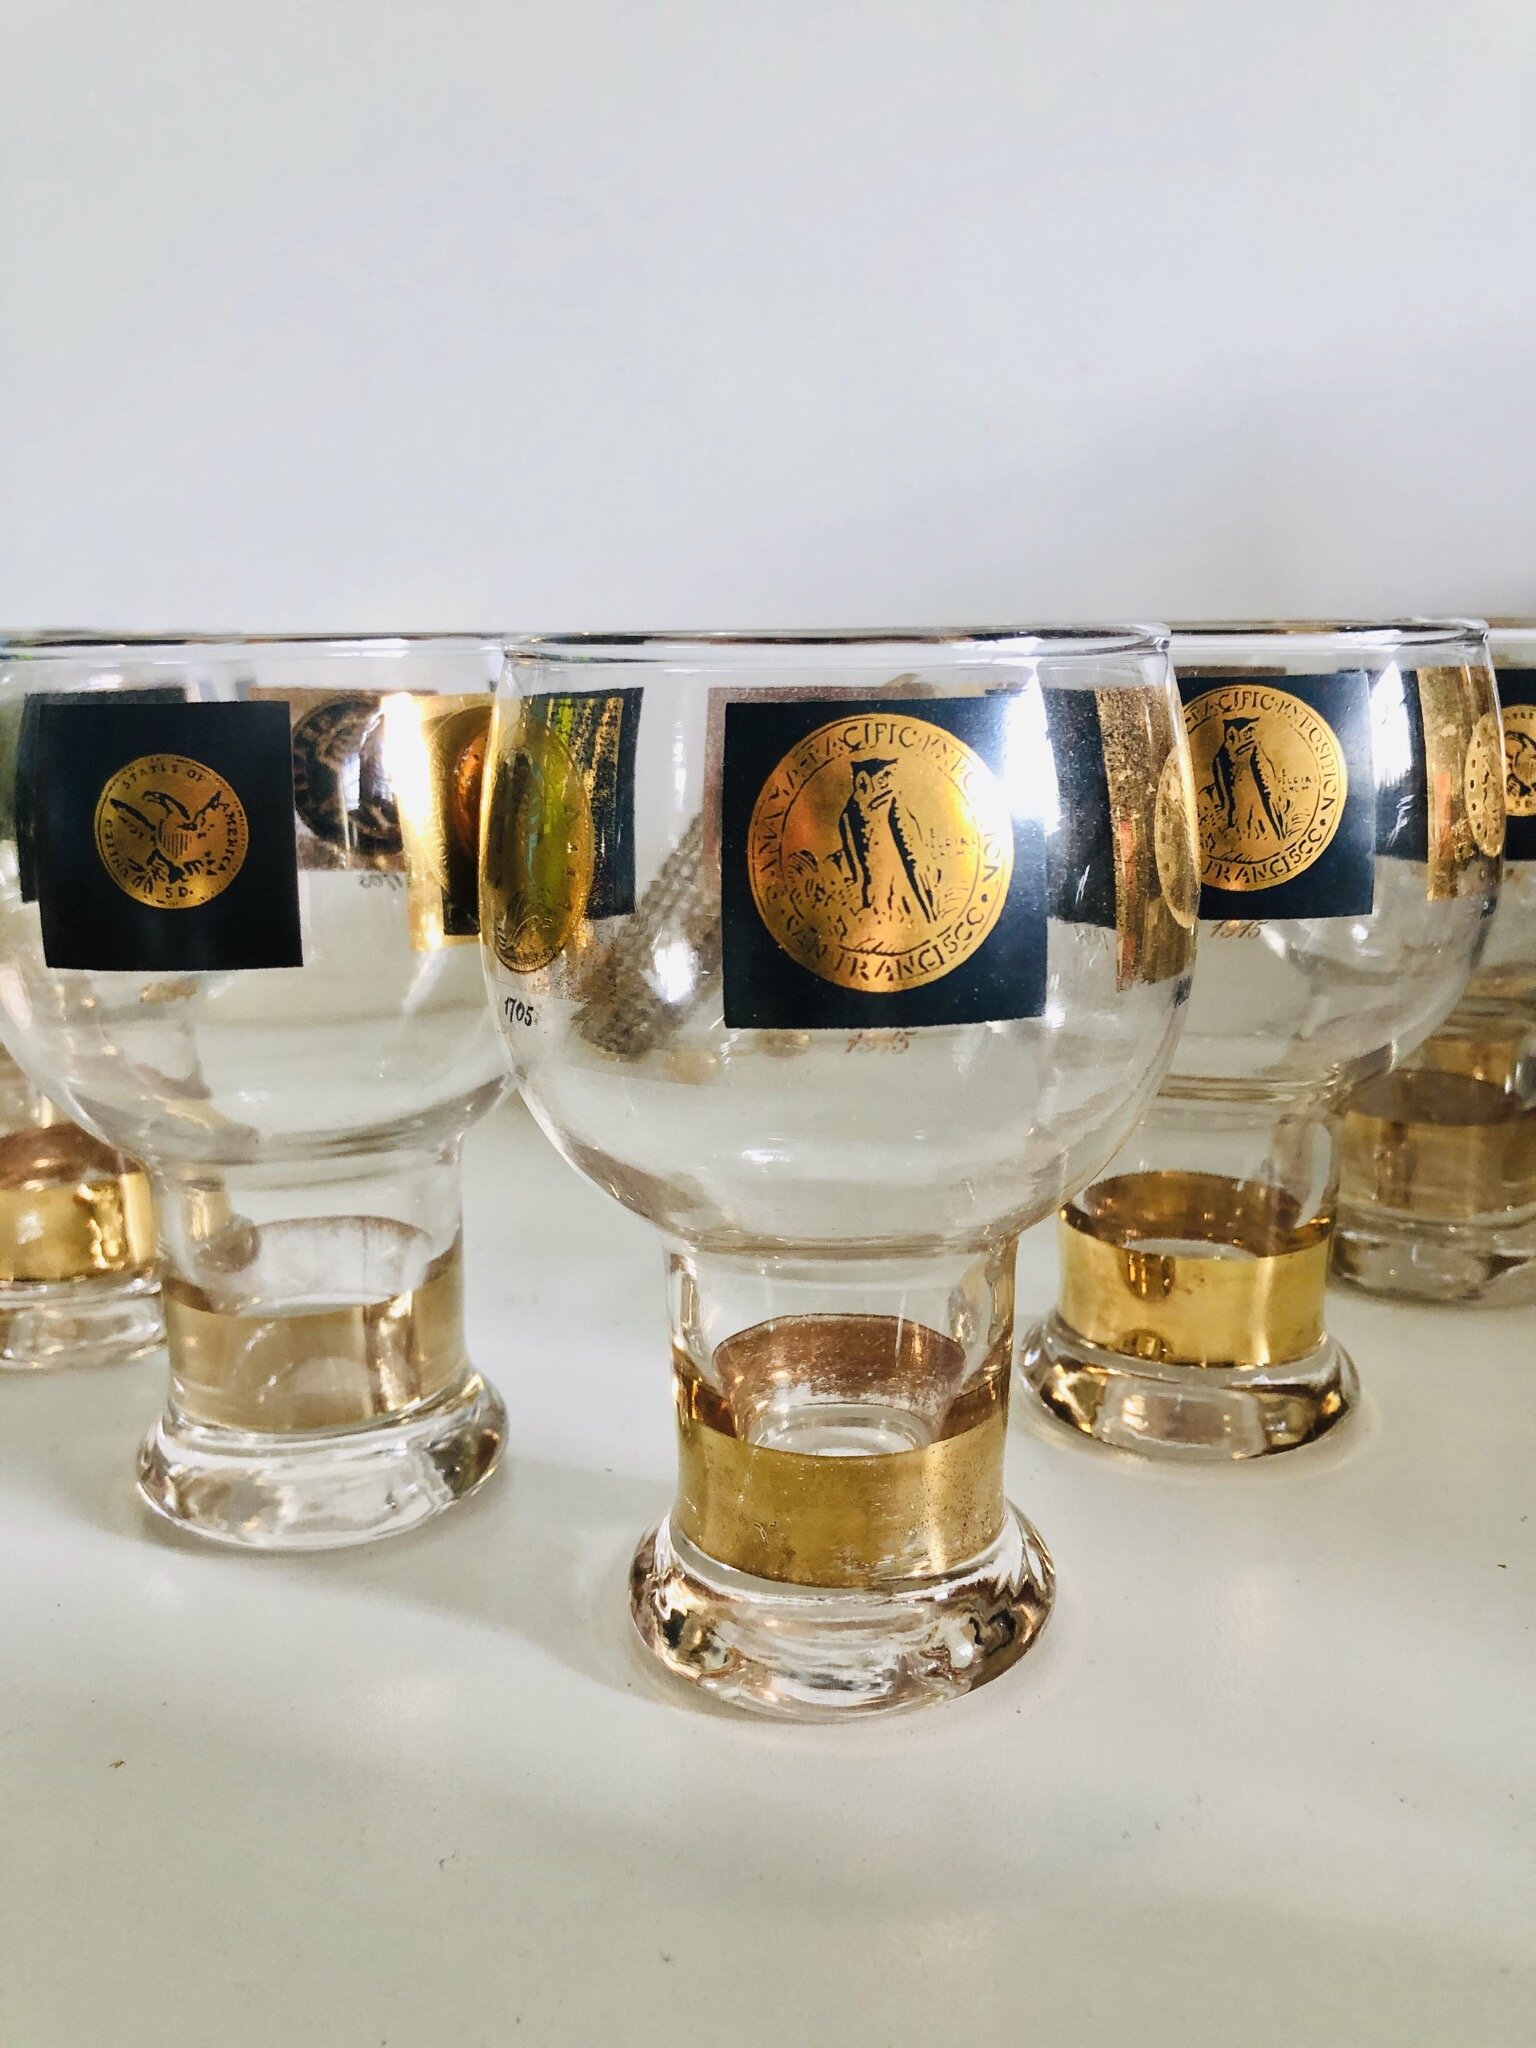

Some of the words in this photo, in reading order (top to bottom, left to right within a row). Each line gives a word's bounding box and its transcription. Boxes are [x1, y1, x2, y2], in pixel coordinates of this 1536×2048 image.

[122, 764, 179, 789] STATES
[187, 769, 206, 783] OF
[217, 802, 239, 872] AMERICA
[833, 906, 985, 983] FRANCISCO
[504, 996, 535, 1027] 1705
